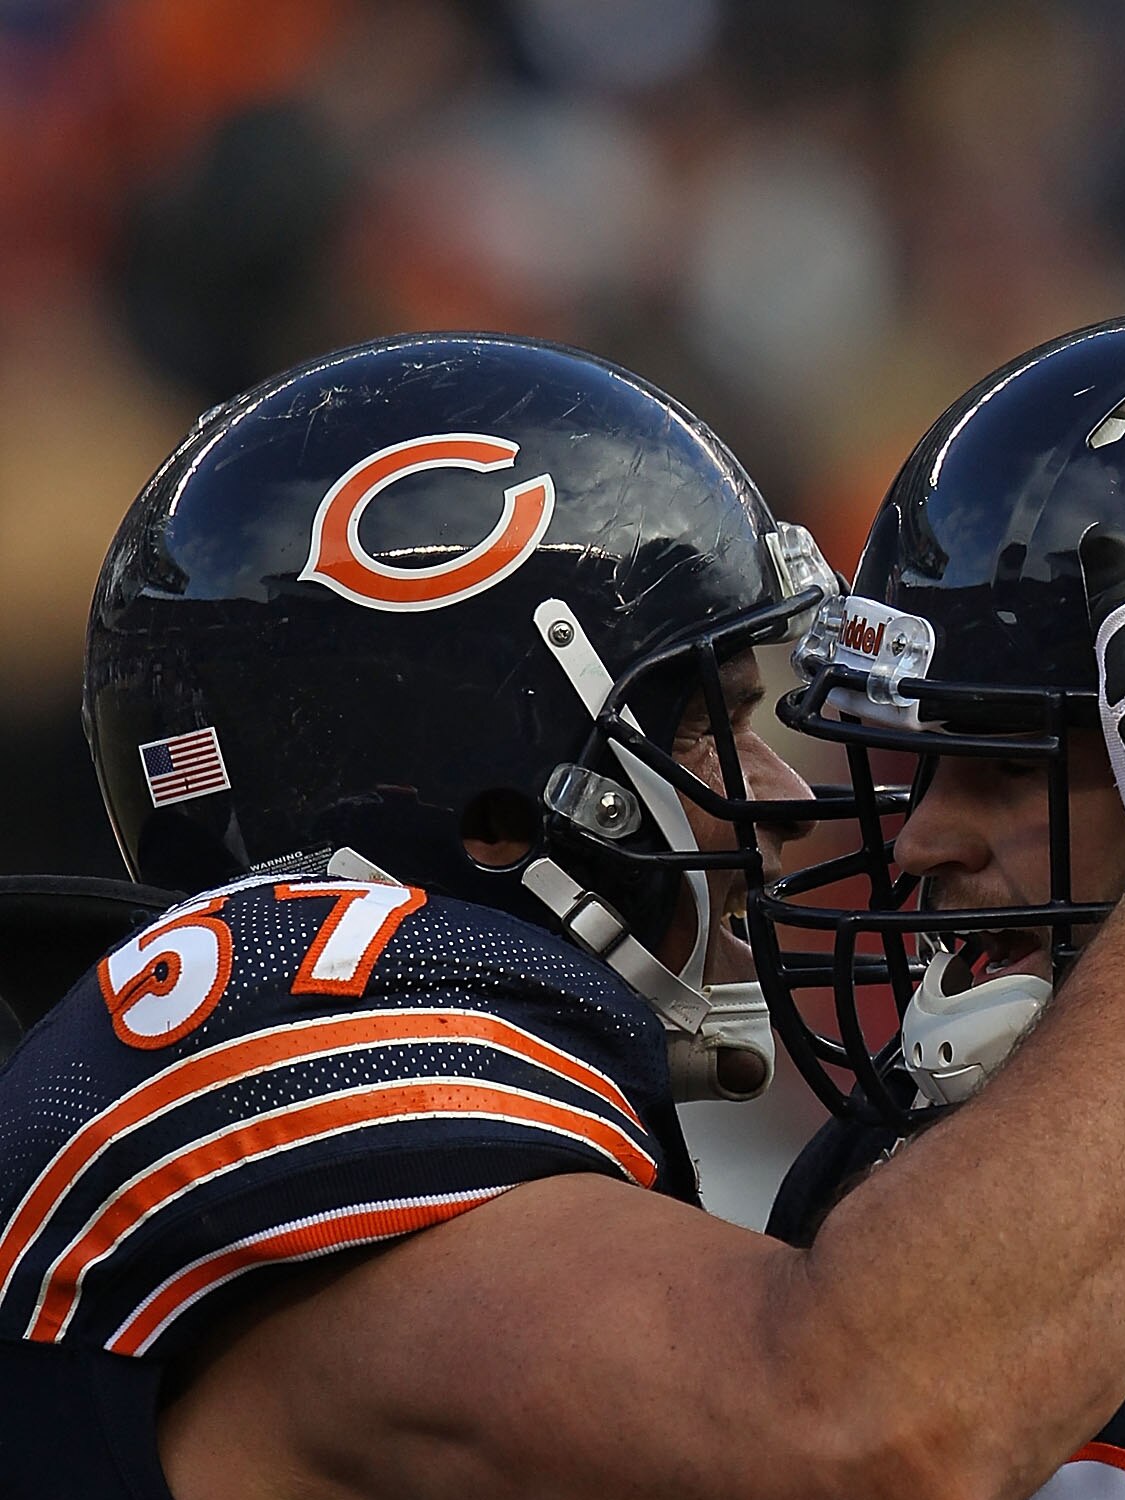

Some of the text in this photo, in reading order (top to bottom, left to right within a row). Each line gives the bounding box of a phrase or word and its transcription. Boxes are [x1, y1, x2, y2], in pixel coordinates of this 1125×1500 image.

[838, 610, 886, 657] iddel
[250, 851, 303, 872] WARNING
[97, 879, 428, 1050] 57
